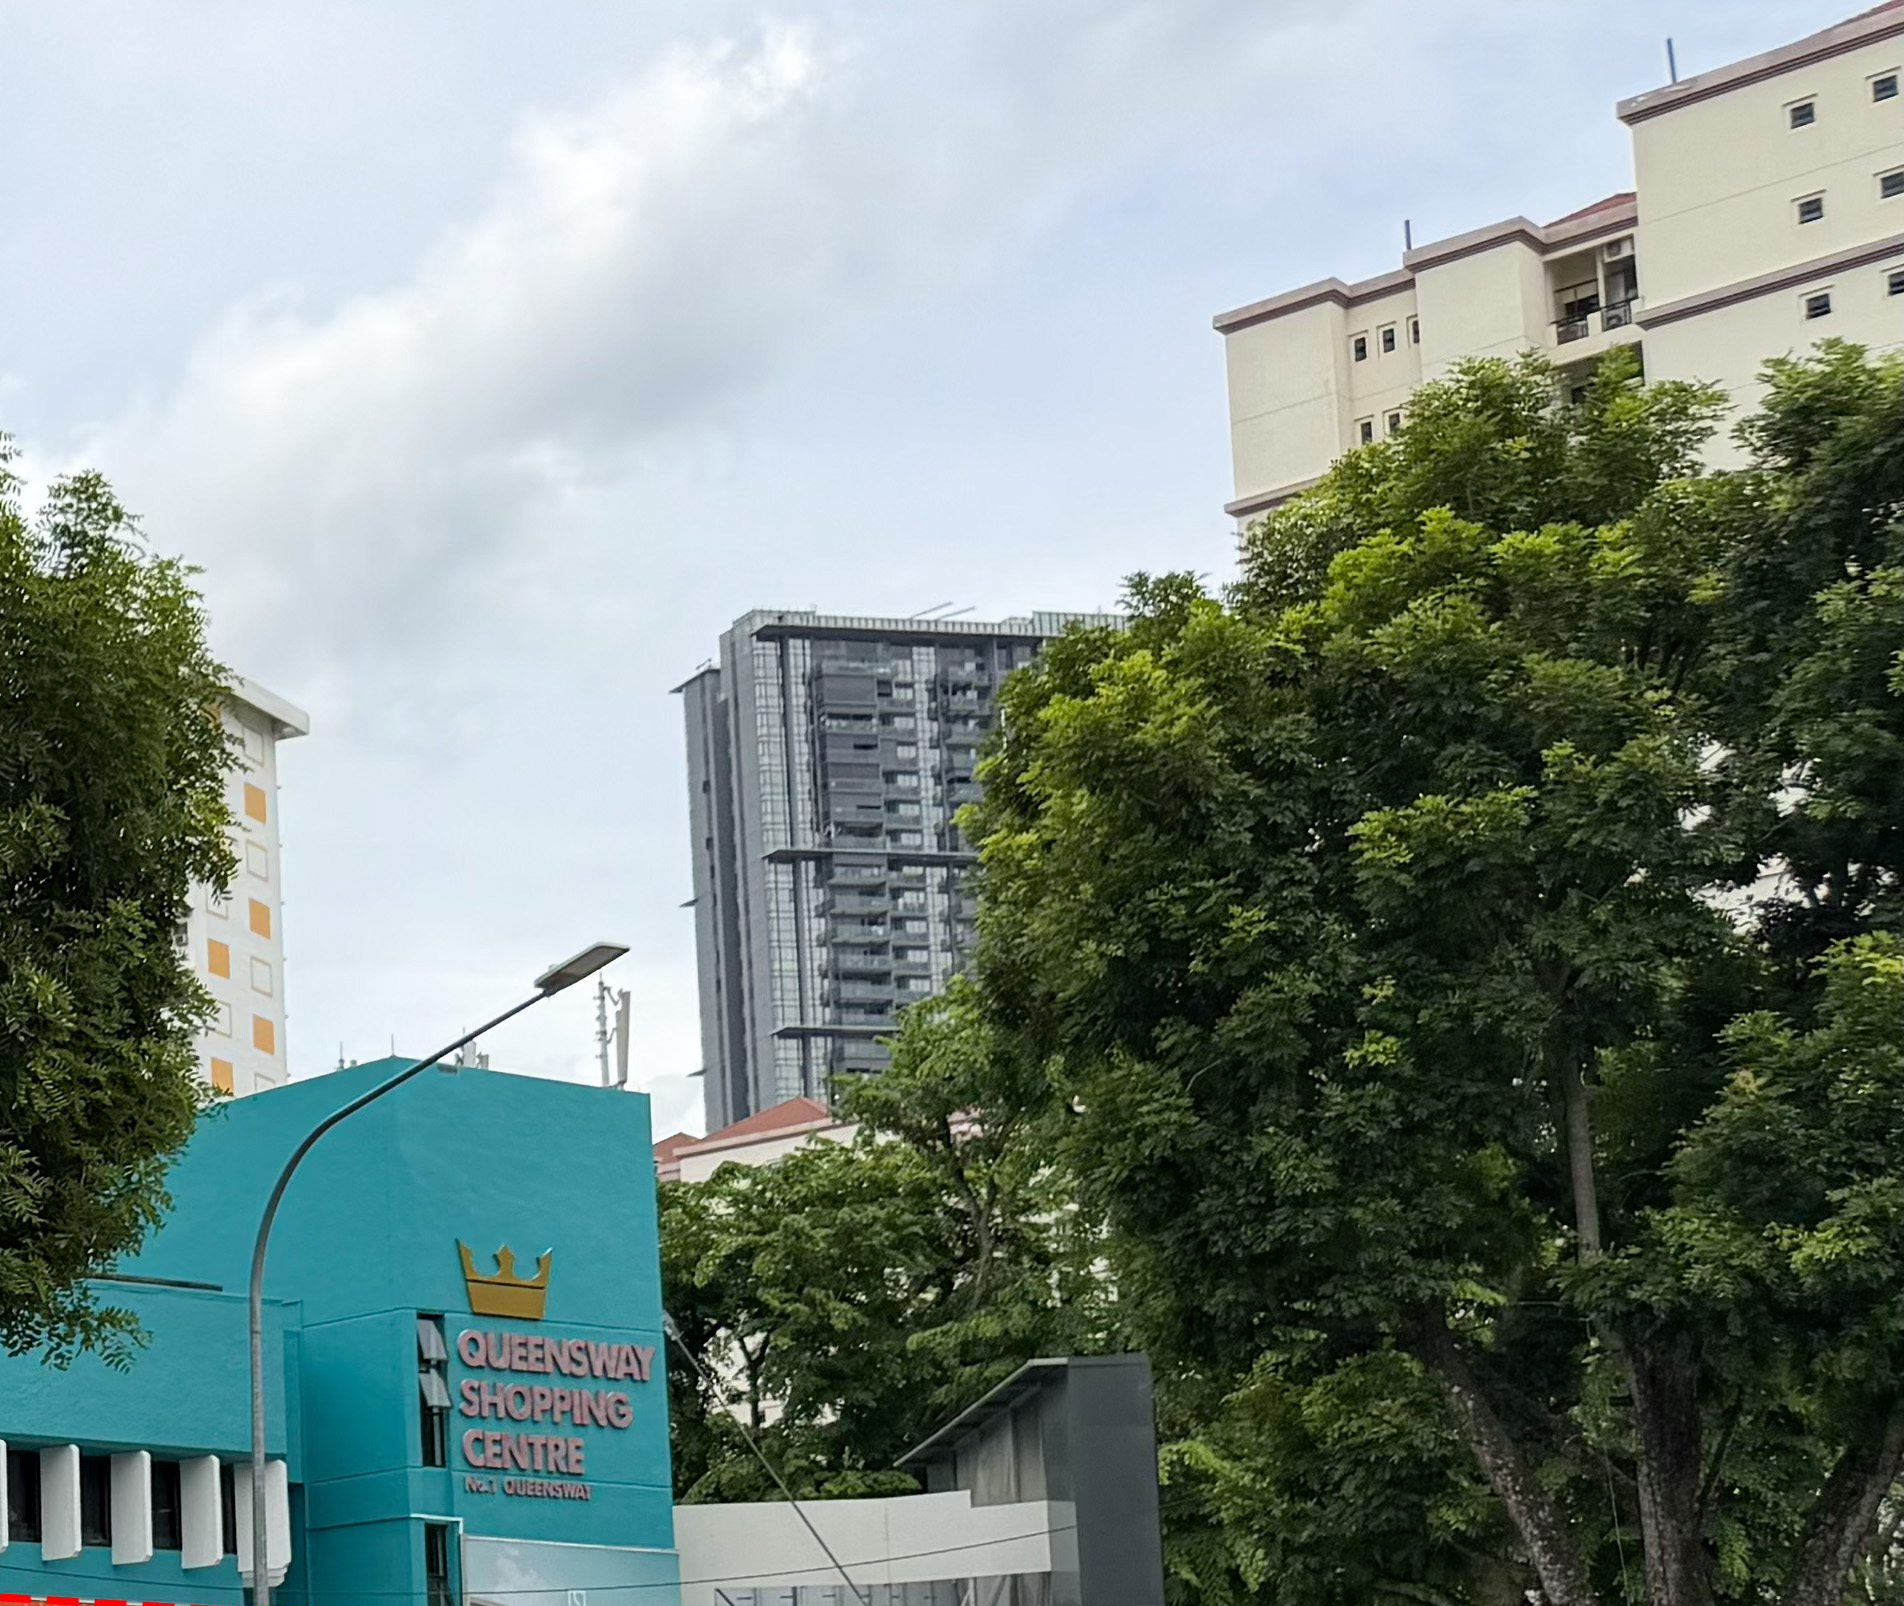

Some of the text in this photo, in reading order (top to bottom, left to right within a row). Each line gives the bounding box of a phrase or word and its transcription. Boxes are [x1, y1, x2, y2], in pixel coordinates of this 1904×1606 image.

[457, 1329, 655, 1382] QUEENSWAY
[459, 1379, 634, 1429] SHOPPING
[463, 1428, 585, 1475] CENTRE
